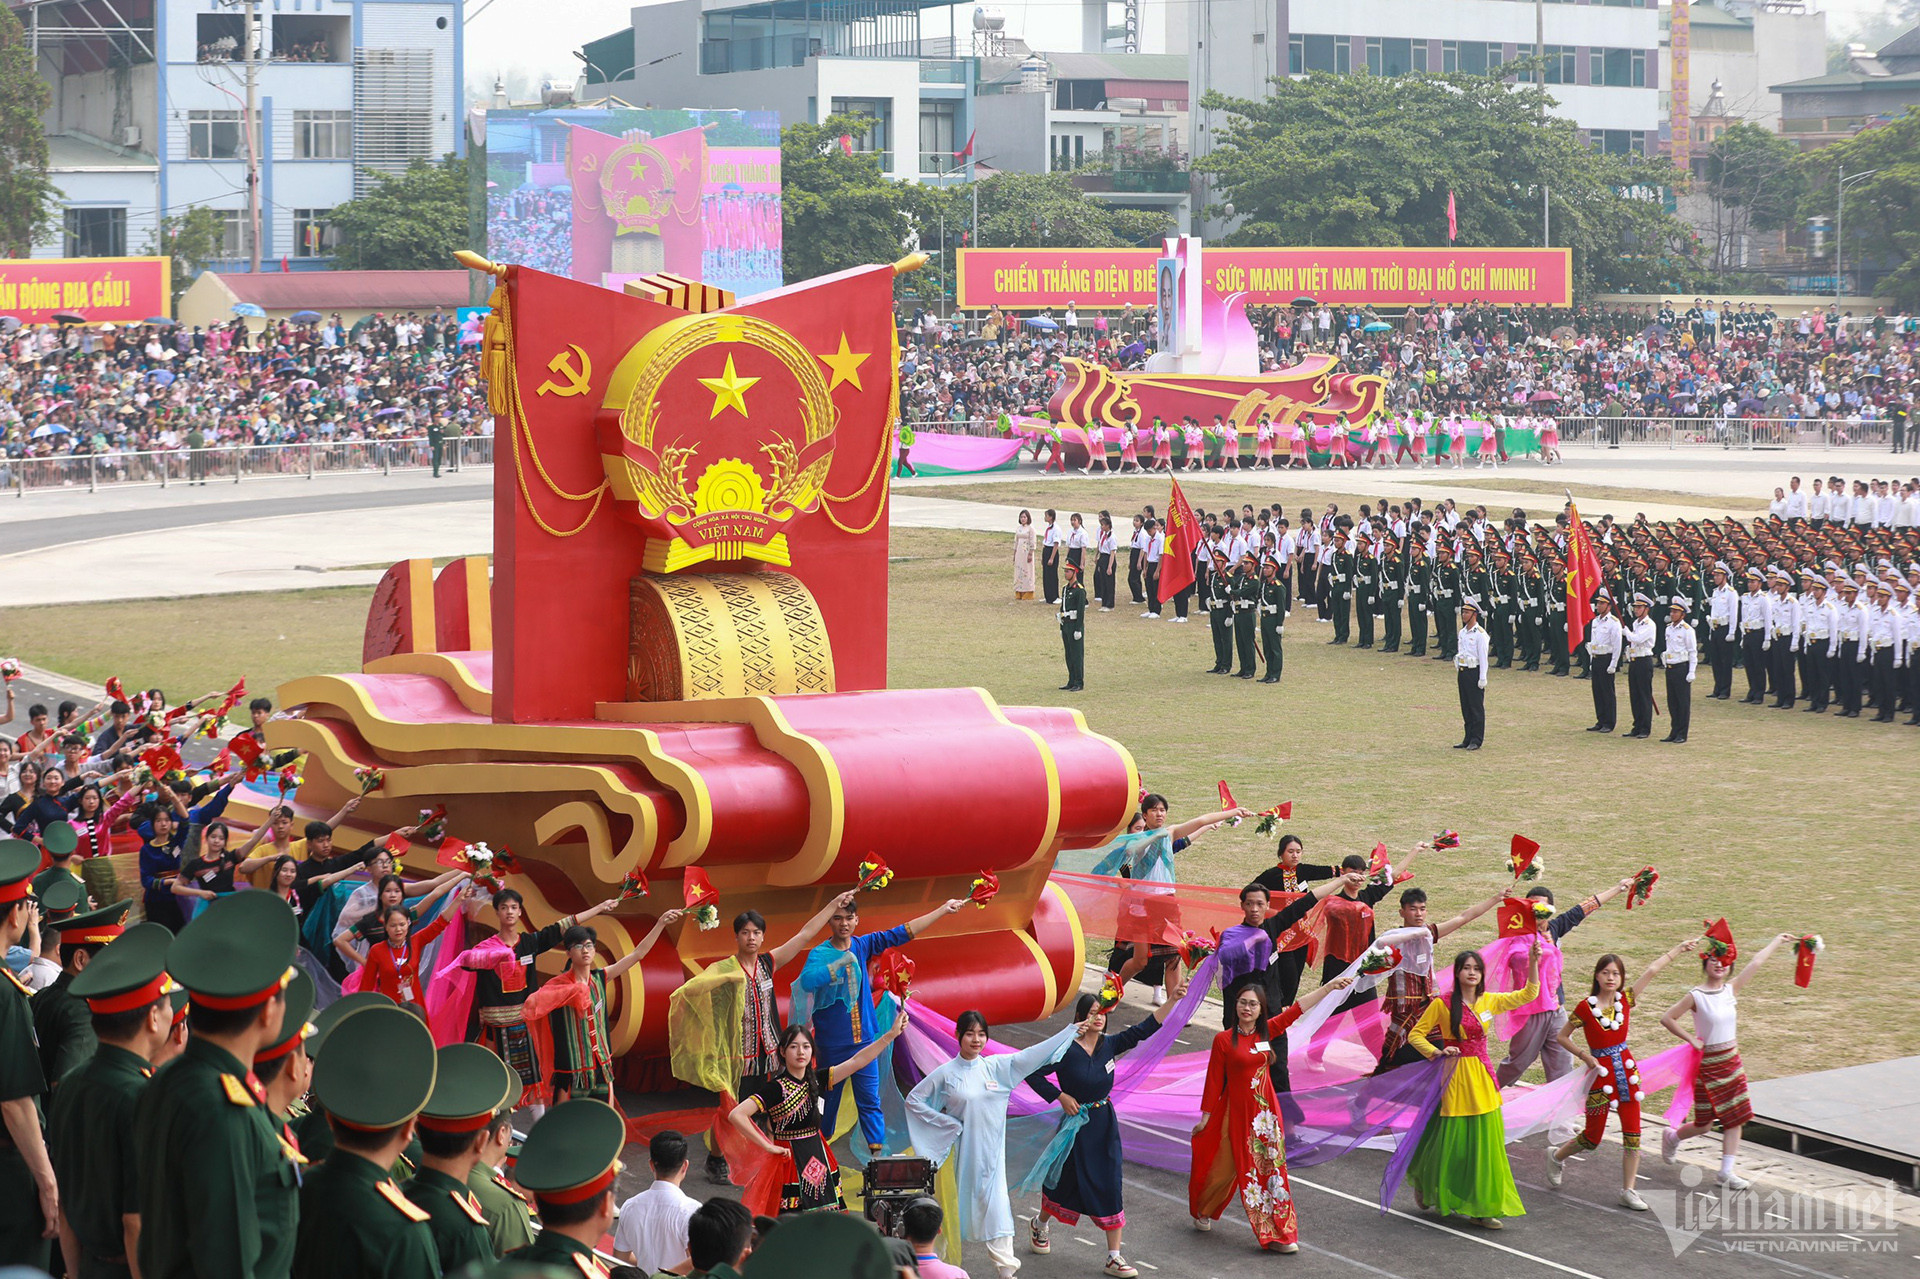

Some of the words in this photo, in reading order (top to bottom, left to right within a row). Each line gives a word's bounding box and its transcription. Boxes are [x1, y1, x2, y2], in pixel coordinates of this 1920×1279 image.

[19, 276, 61, 316] ĐỘNG
[63, 281, 89, 313] ĐỊA
[994, 260, 1038, 293] CHIẾN
[1043, 260, 1090, 293] THẮNG
[1094, 264, 1129, 298] ĐIỆN
[1133, 264, 1157, 293] BIÊ
[1216, 263, 1245, 292] SỨC
[1250, 267, 1294, 297] MẠNH
[1297, 262, 1328, 296] VIỆT
[1332, 267, 1367, 291] NAM
[1371, 262, 1403, 291] THỜI
[1408, 267, 1432, 296] ĐẠI
[1437, 260, 1457, 291] HỒ
[1461, 263, 1485, 291] CHÍ
[698, 523, 730, 540] VIỆT
[733, 524, 765, 539] NAM
